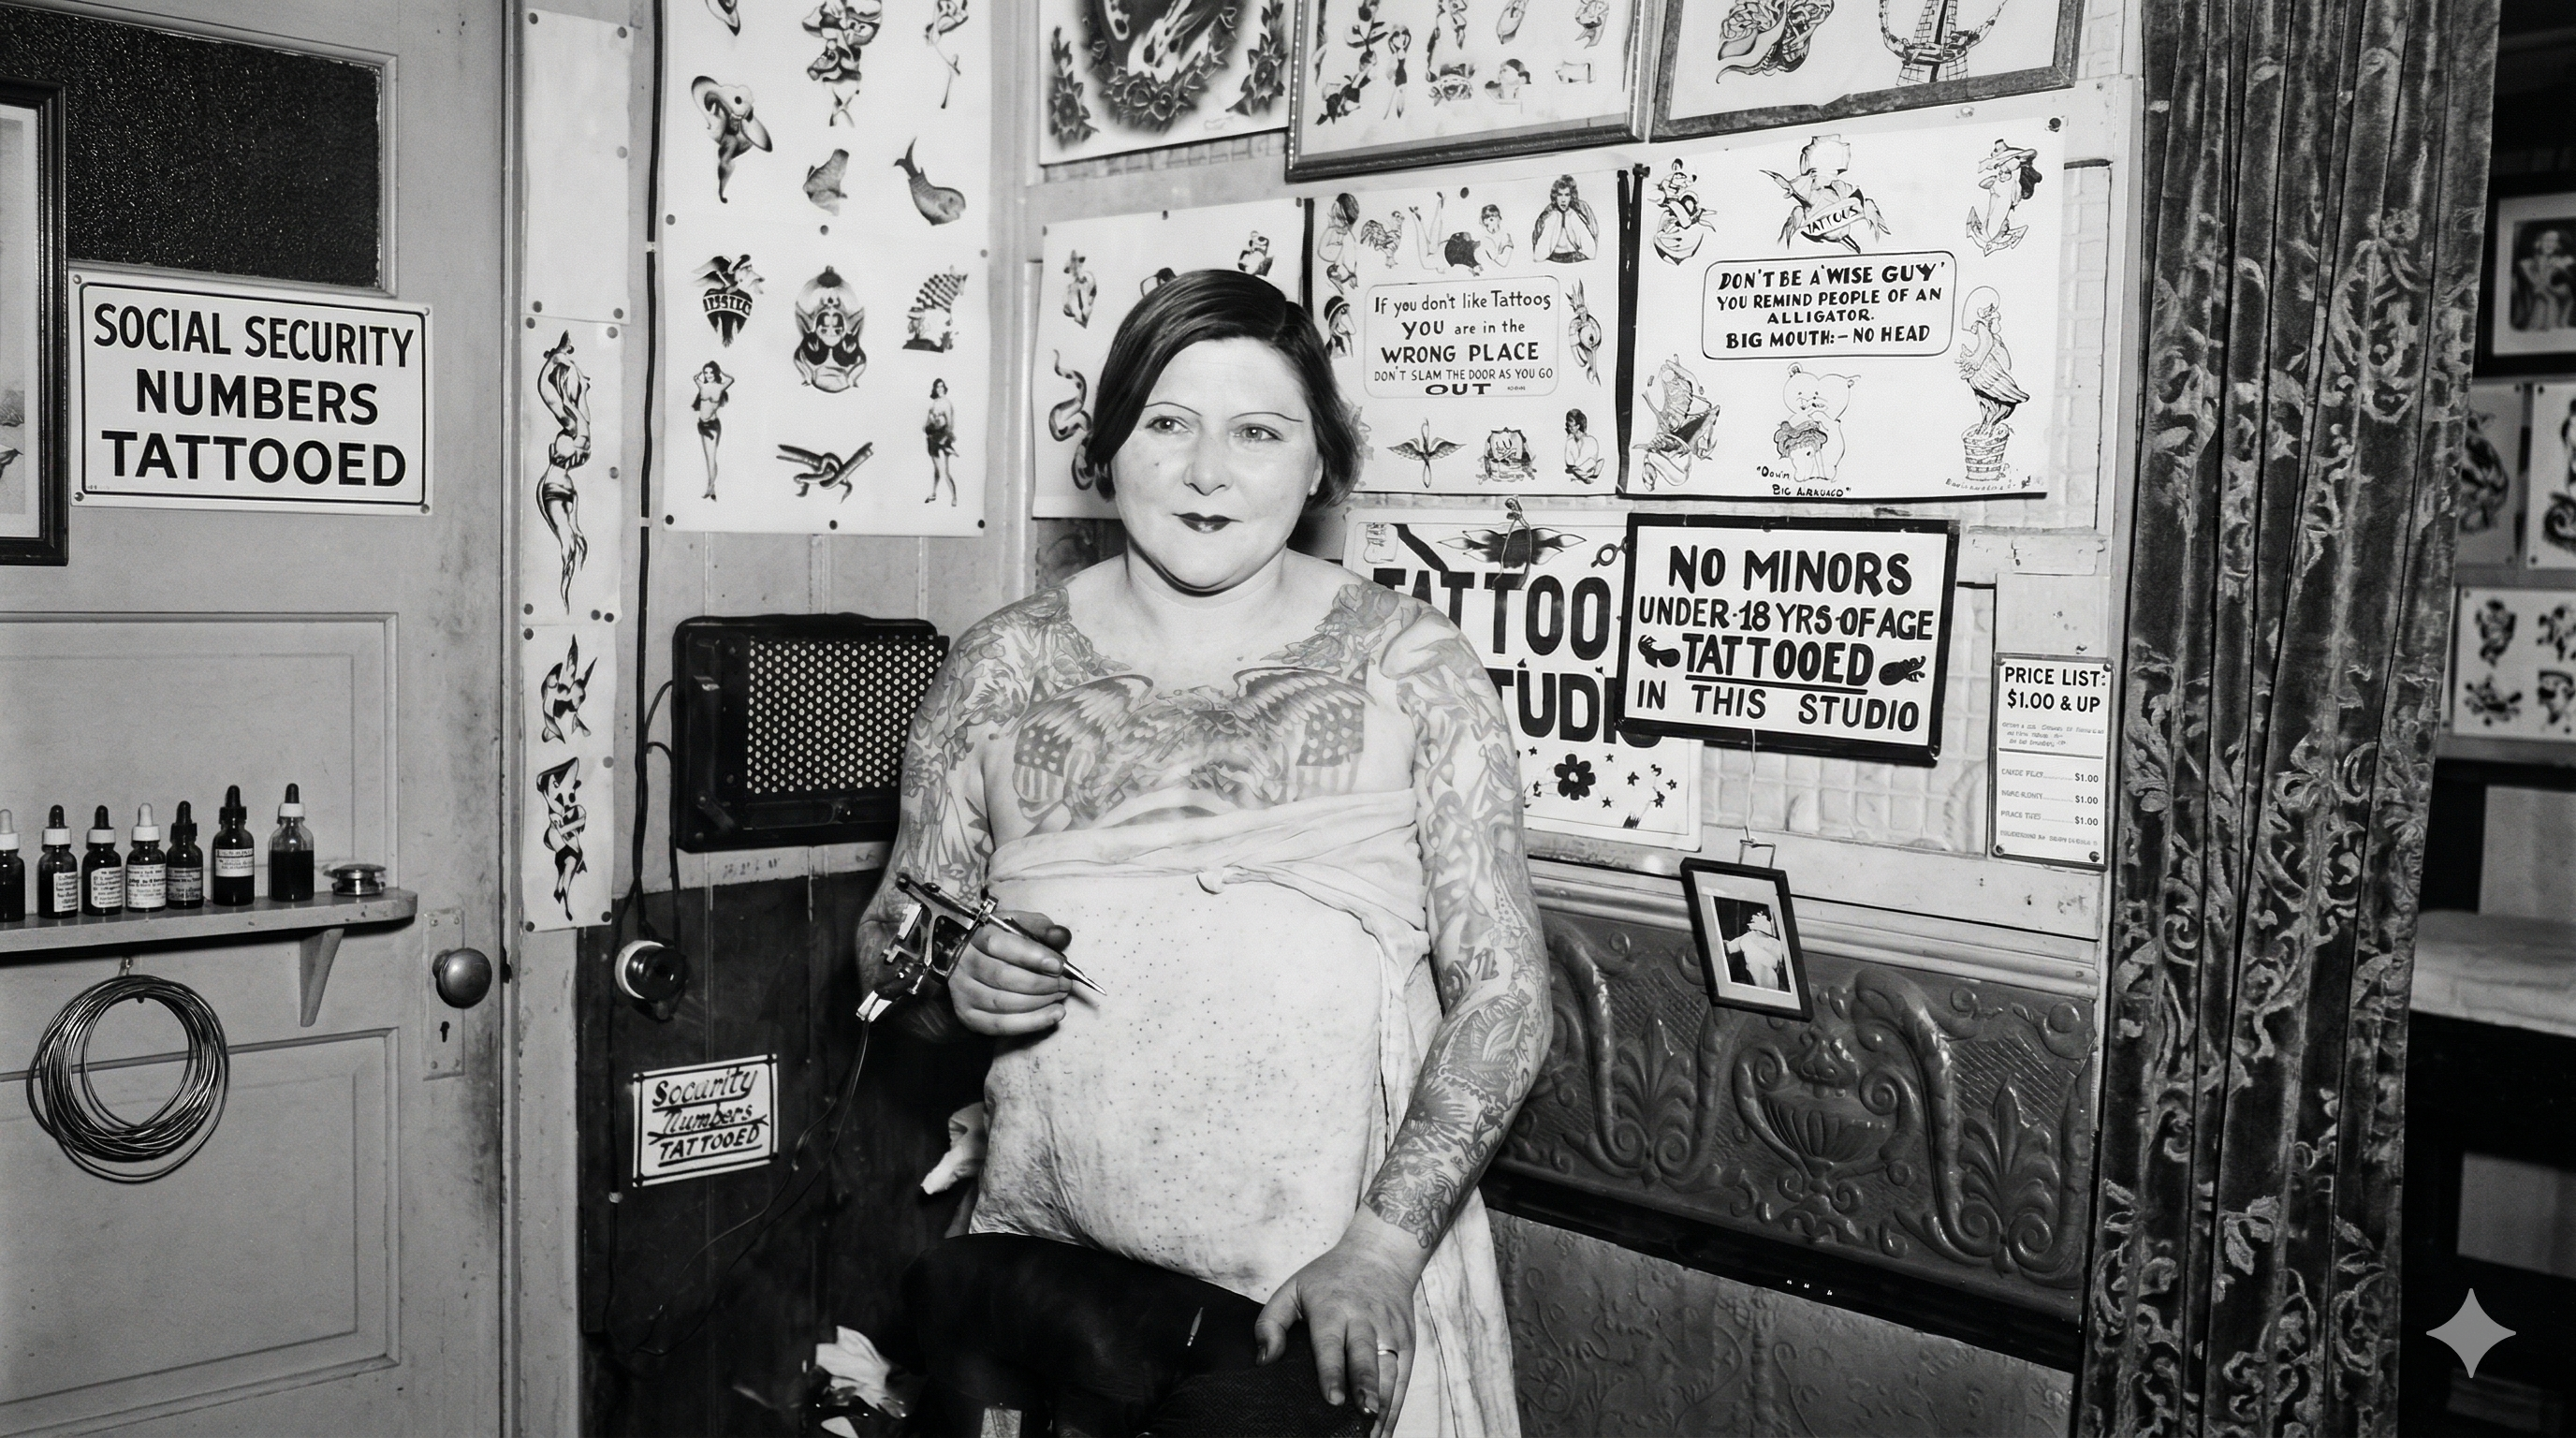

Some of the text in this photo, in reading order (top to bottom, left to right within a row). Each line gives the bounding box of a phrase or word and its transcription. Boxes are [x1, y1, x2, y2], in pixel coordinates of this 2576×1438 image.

[1718, 269, 1775, 290] DON'T
[1778, 270, 1802, 287] BE
[1809, 270, 1821, 286] A
[1374, 290, 1551, 318] If you don't like Tattoos
[1717, 287, 1942, 311] YOU REMIND PEOPLE OF AN
[1455, 324, 1476, 335] are
[1483, 320, 1496, 333] in
[1501, 318, 1526, 332] the
[1766, 308, 1875, 324] ALLIGATOR.
[94, 302, 415, 368] SOCIAL SECURITY
[1725, 331, 1763, 349] BIG
[1852, 327, 1875, 344] NO
[1881, 325, 1930, 342] HEAD
[1381, 342, 1539, 364] WRONG PLACE
[1374, 365, 1554, 382] DON'T SLAM THE DOOR AS YOU GO
[136, 368, 378, 426] NUMBERS
[1425, 383, 1491, 396] OUT
[101, 430, 406, 487] TATTOOED
[1668, 544, 1912, 597] NO MINORS
[1876, 607, 1934, 640] AGE
[1682, 633, 1875, 686] TATTOOED
[2004, 666, 2106, 687] PRICE LIST:
[1637, 680, 1920, 732] IN THIS STUDIO
[2007, 688, 2101, 713] $1.00 & UP
[2074, 772, 2100, 784] $1.00
[2074, 795, 2099, 805] $1.00
[2074, 815, 2100, 827] $1.00
[660, 1123, 760, 1160] TATTOOED
